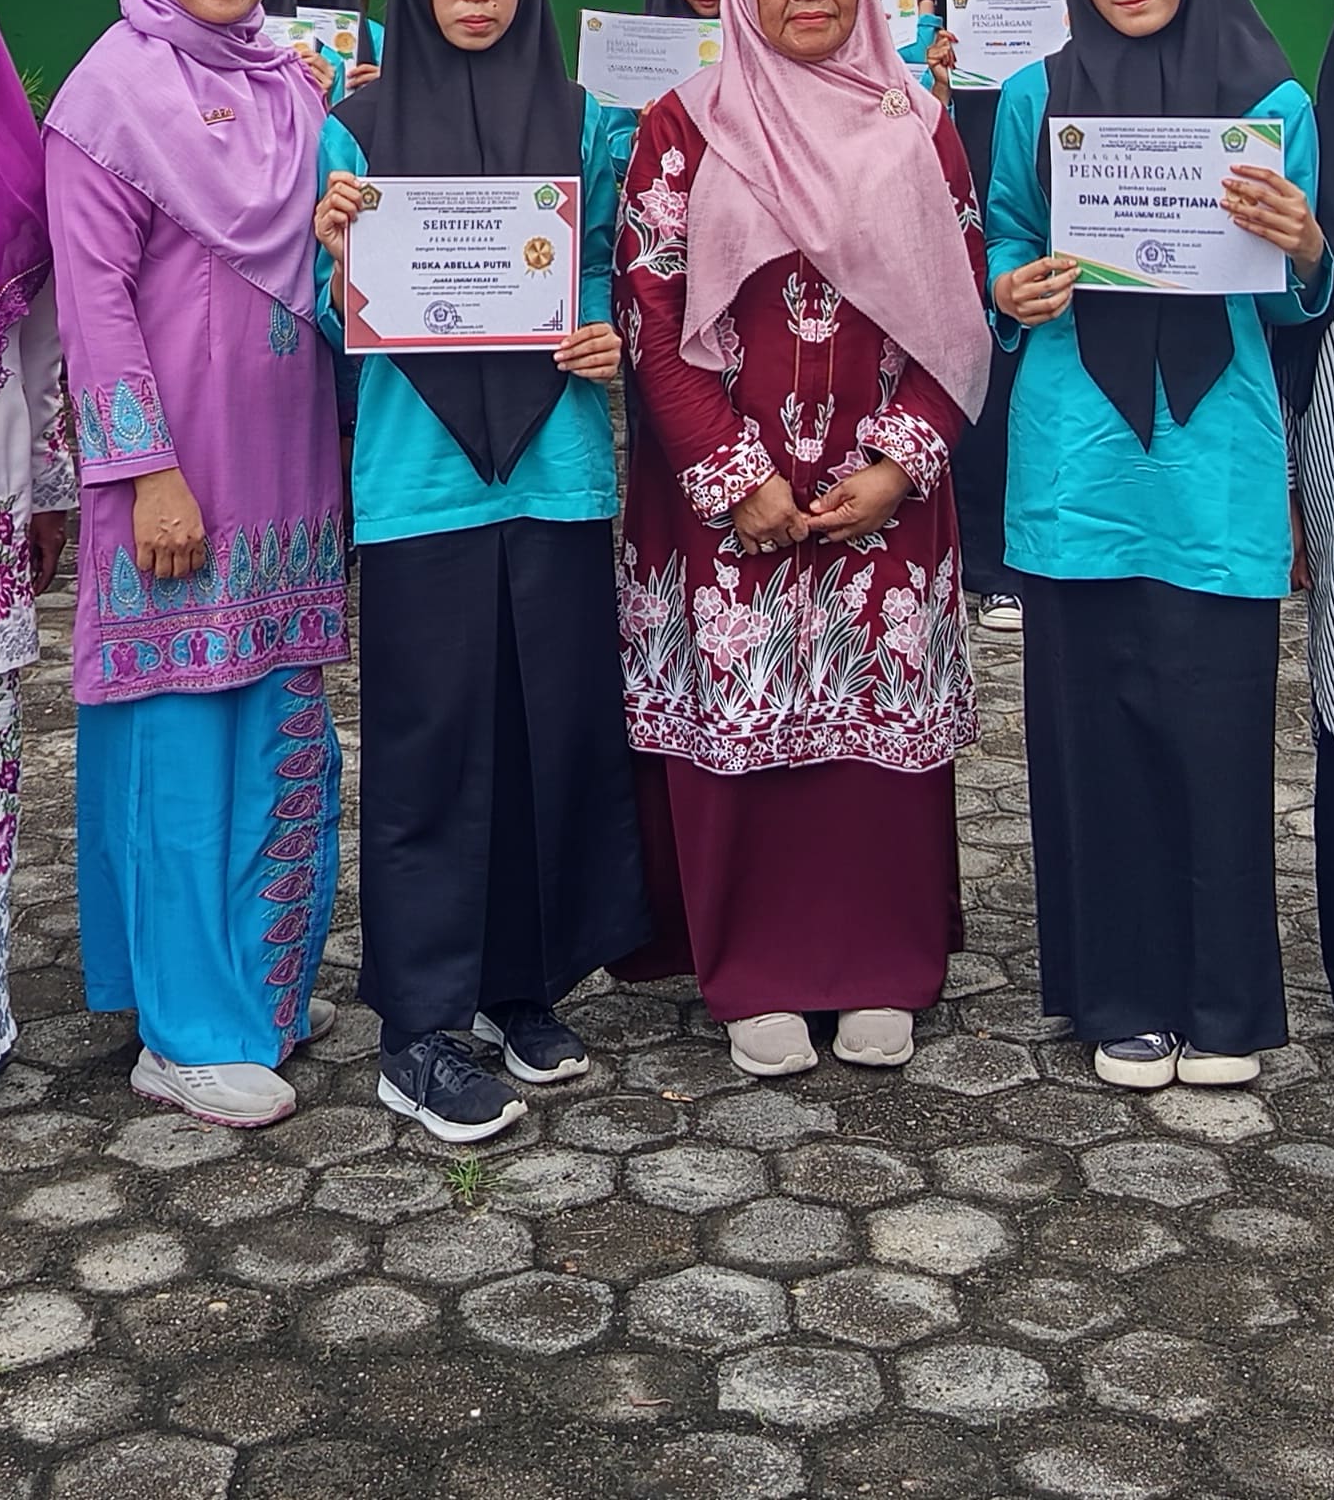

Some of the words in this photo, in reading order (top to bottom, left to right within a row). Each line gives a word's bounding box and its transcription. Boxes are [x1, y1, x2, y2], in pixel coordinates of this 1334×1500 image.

[1072, 153, 1132, 161] PIAGAM
[1069, 164, 1203, 181] PENGHARGAAN
[1079, 194, 1109, 205] DINA
[1113, 195, 1149, 207] ARUM
[1153, 197, 1218, 209] SEPTIANA
[423, 219, 503, 230] SERTIFIKAT
[411, 261, 441, 269] RISKA
[443, 261, 481, 269] ABELLA
[483, 261, 511, 269] PUTRI
